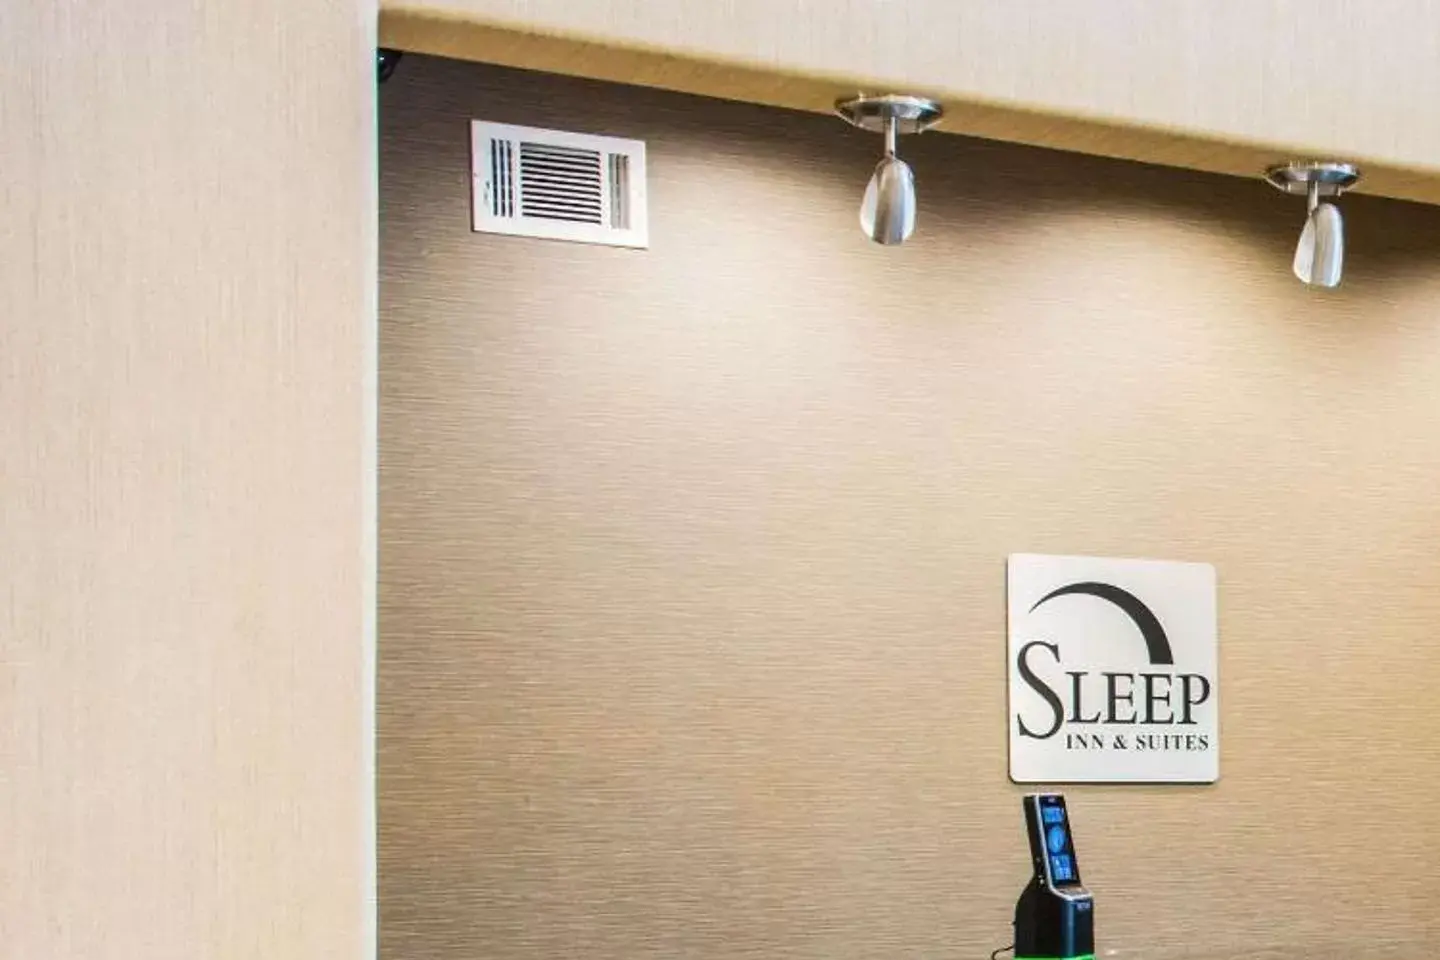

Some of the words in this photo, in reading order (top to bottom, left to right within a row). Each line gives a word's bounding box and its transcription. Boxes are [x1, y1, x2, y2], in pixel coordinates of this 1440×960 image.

[1017, 640, 1210, 740] SLEEP
[1066, 734, 1105, 750] INN
[1113, 734, 1129, 750] &
[1136, 734, 1210, 751] SUITES
